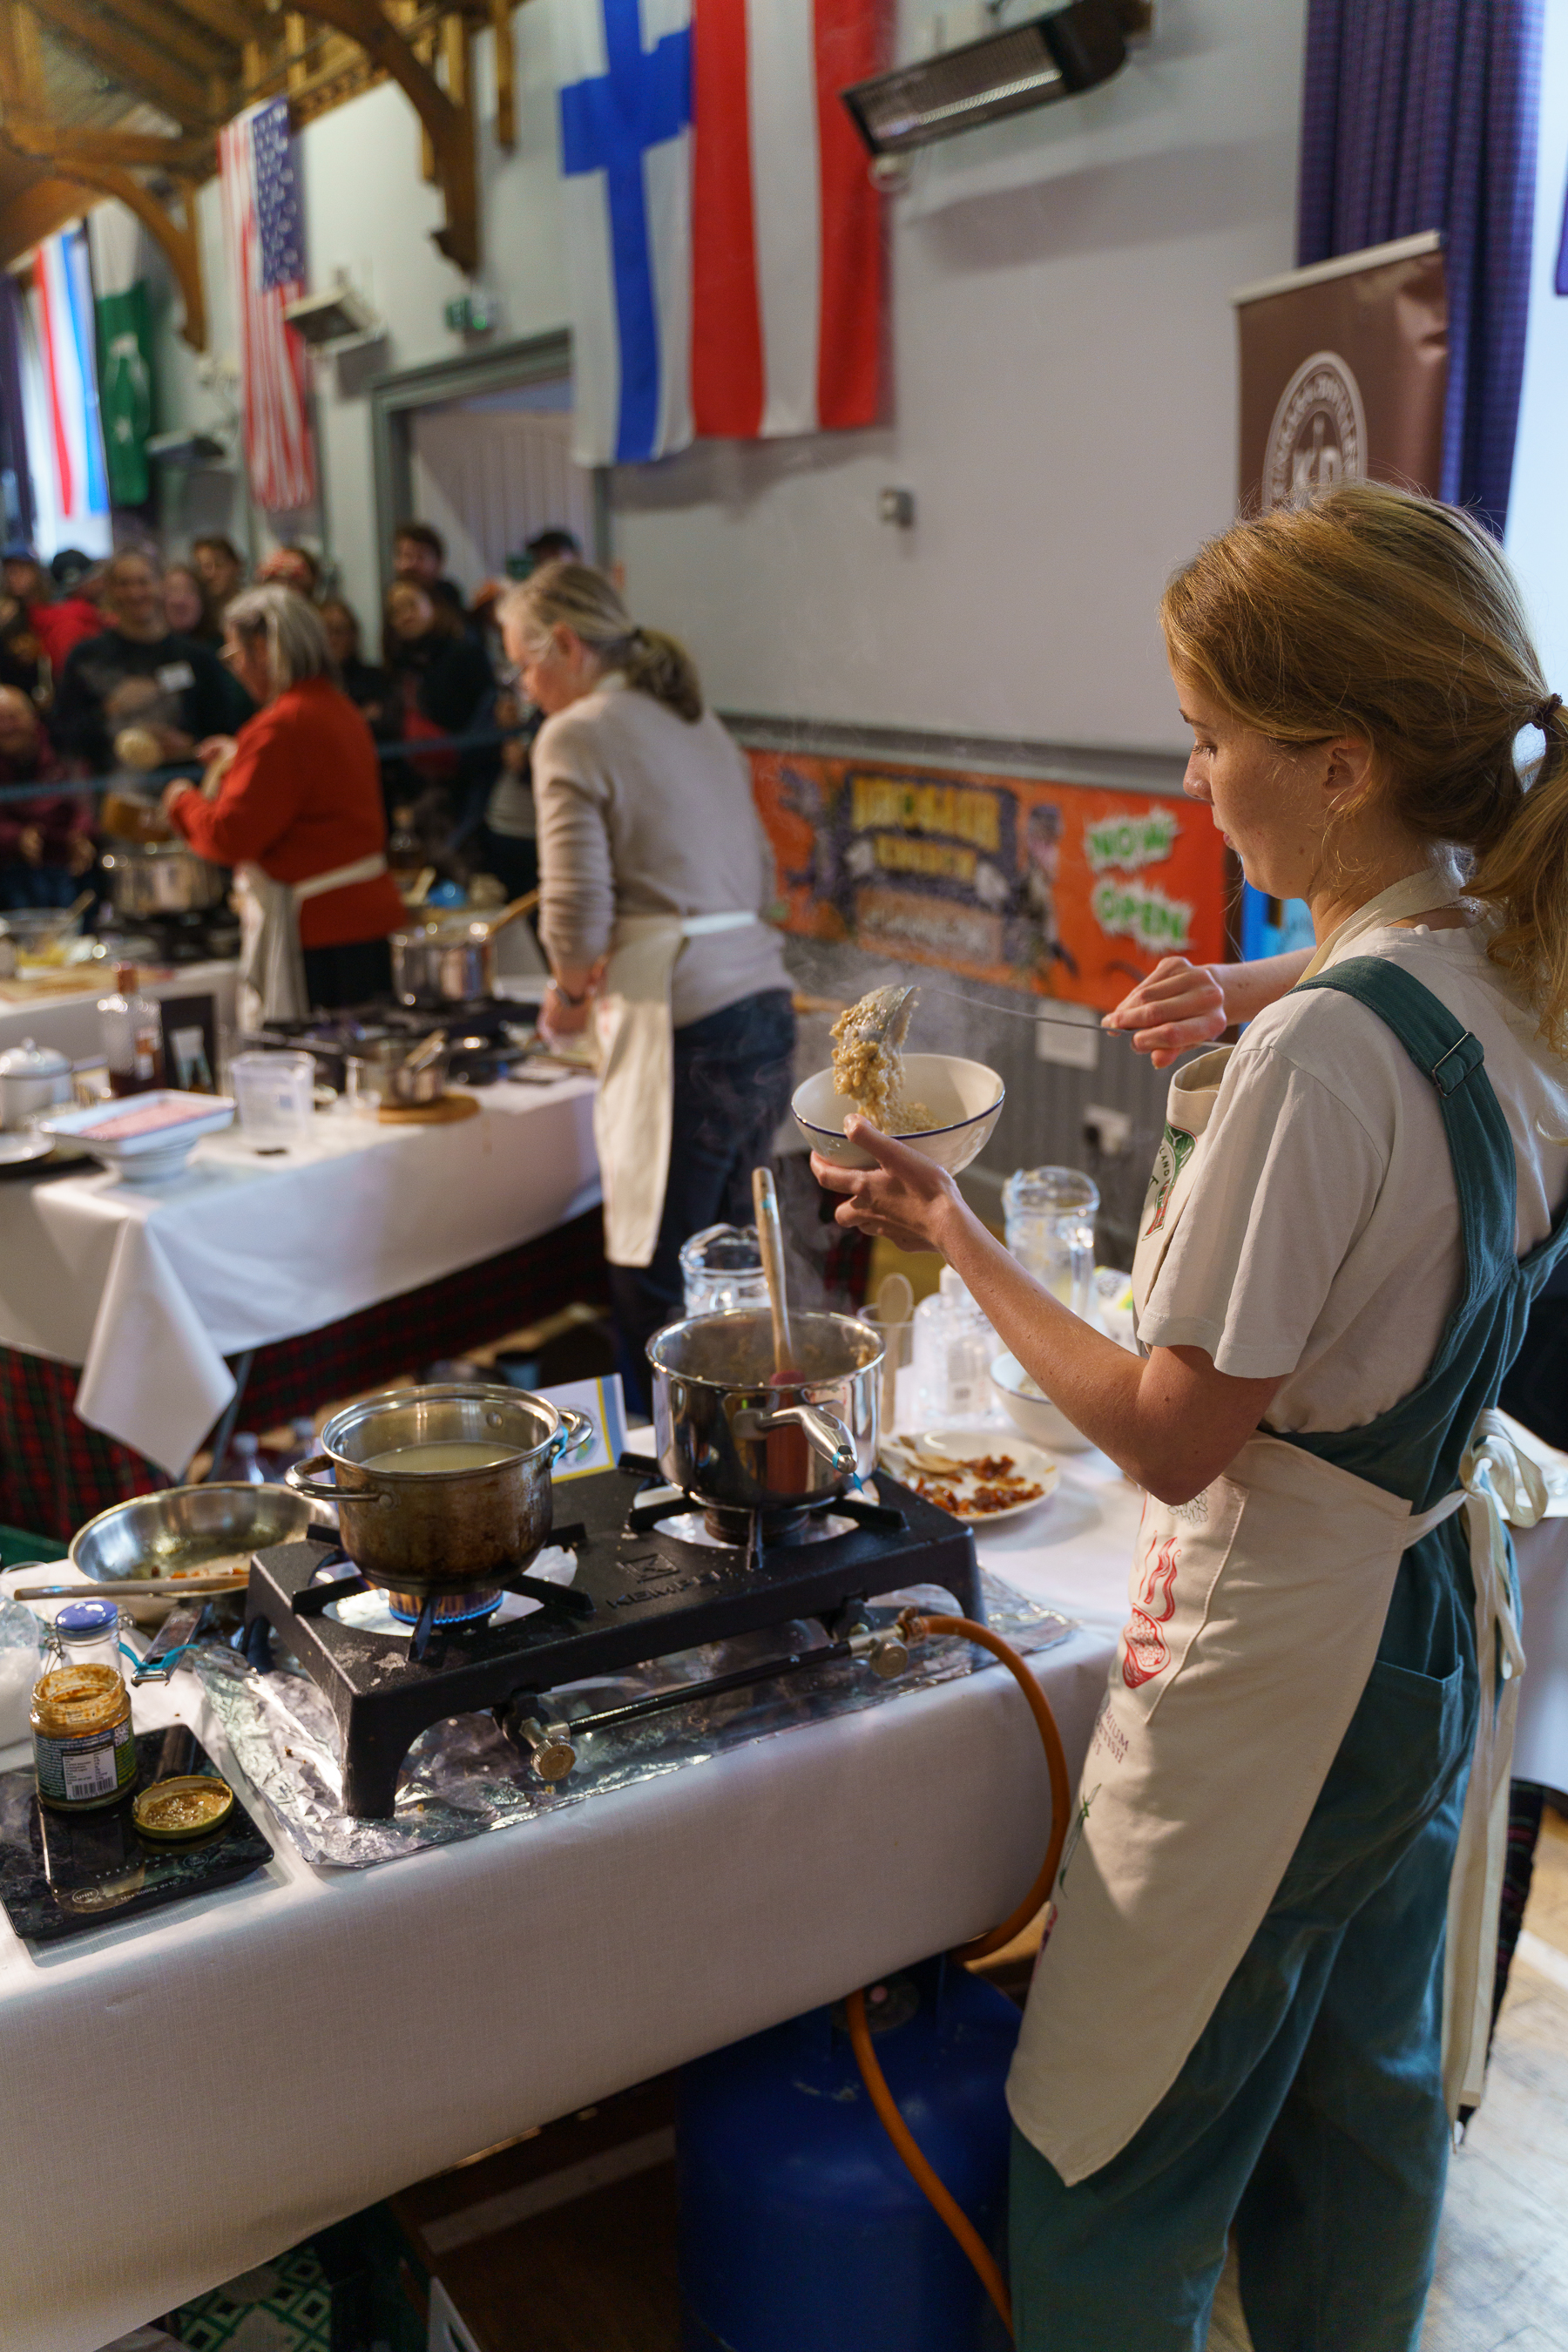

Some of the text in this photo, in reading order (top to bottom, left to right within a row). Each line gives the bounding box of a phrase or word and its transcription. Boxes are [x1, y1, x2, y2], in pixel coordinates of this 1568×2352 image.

[1090, 818, 1174, 858] NOW
[1094, 889, 1186, 943] OPEN
[605, 1570, 732, 1609] KEMPE
[75, 1891, 94, 1901] UNIT
